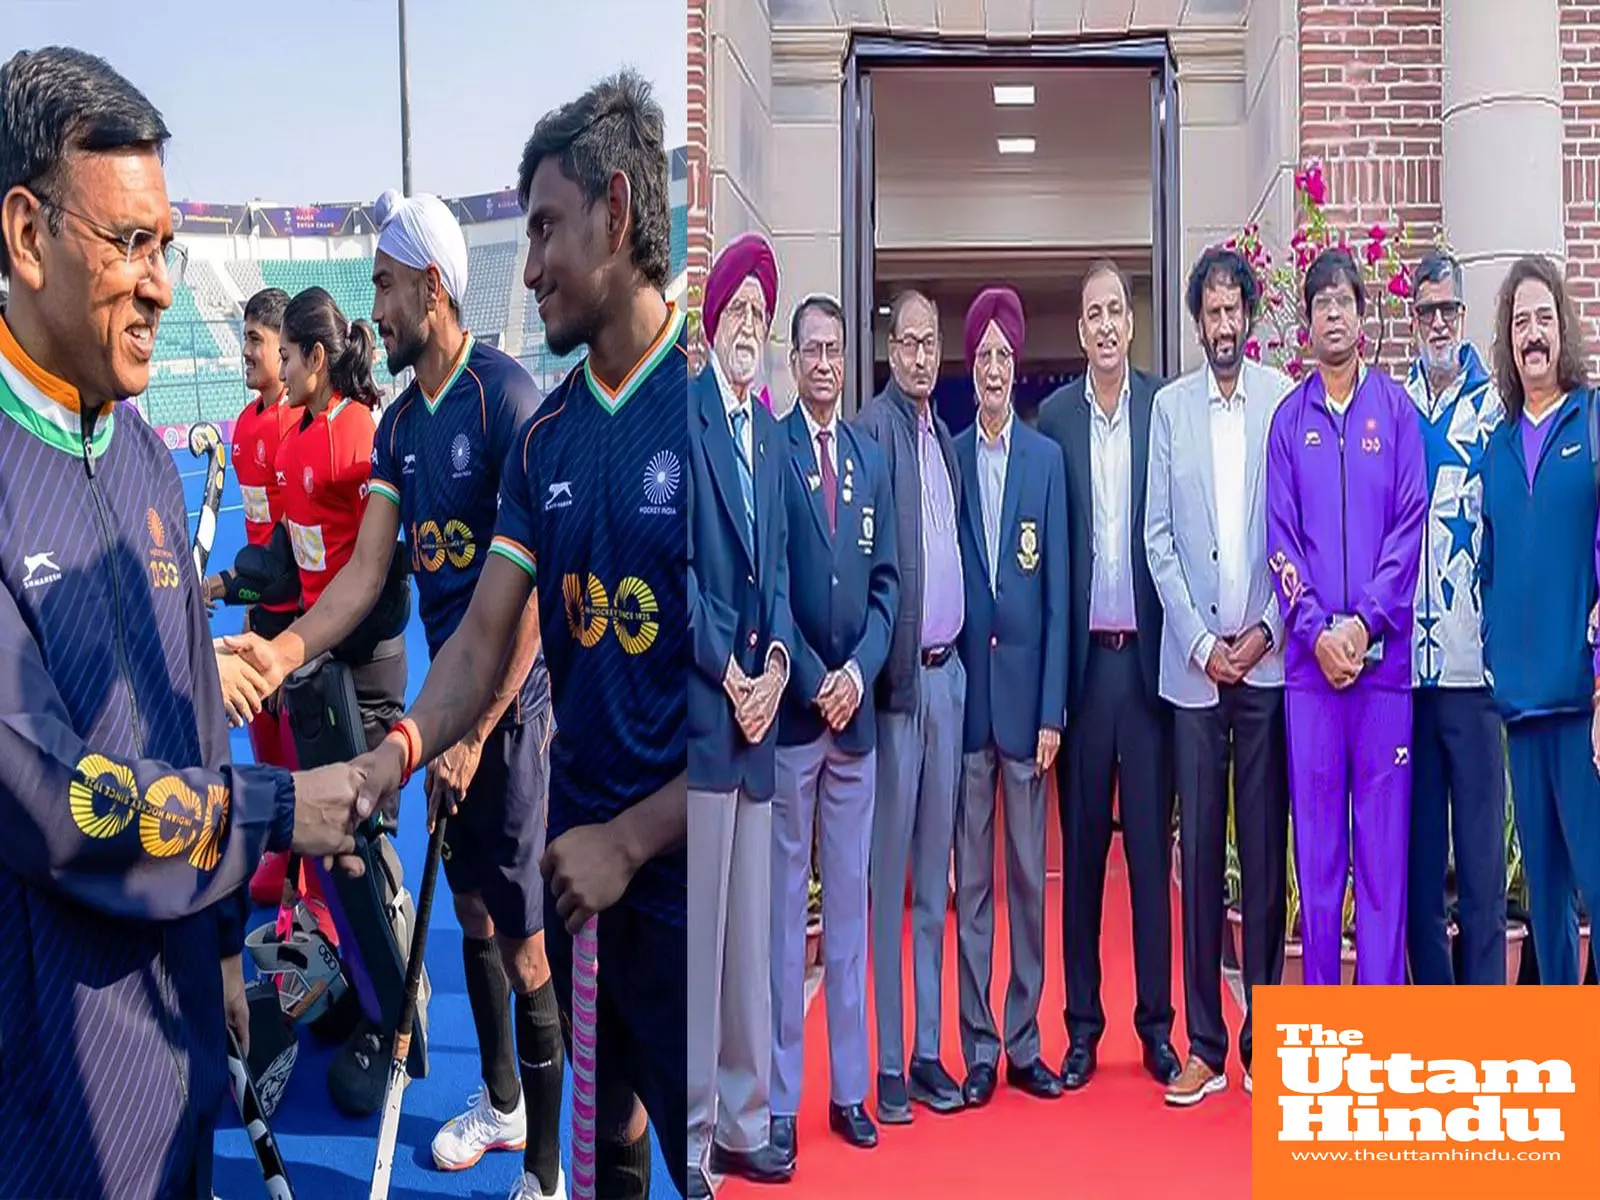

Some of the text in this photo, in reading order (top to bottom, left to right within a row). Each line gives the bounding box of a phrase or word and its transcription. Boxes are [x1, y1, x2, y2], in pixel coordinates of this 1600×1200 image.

[103, 786, 129, 805] SINCE
[130, 797, 165, 819] HOCKEY
[165, 812, 192, 826] INDIAN
